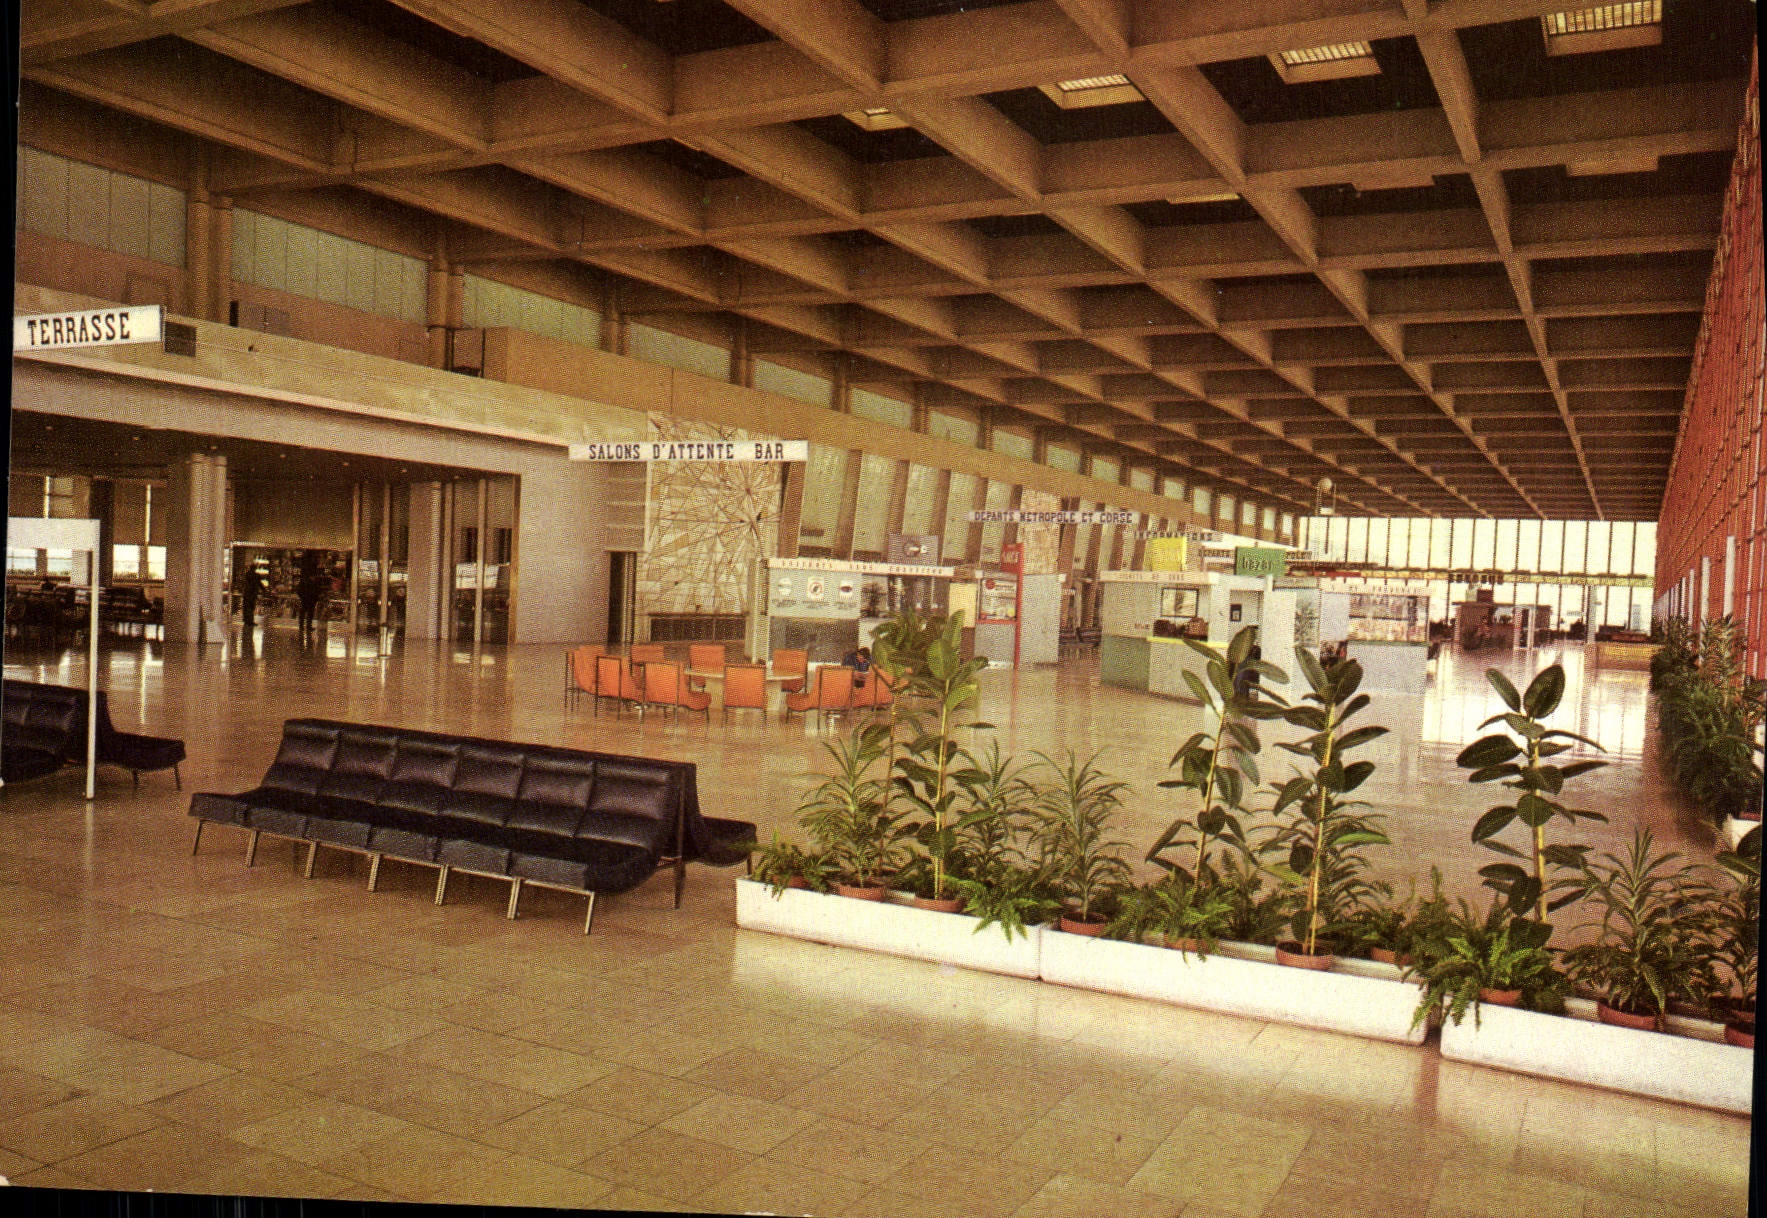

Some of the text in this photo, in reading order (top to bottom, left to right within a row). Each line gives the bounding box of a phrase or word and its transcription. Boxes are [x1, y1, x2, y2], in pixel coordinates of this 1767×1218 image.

[27, 312, 131, 346] TERRASSE
[588, 442, 785, 461] SALONS D'ATTENTE BAR
[1081, 512, 1094, 523] ET
[1100, 512, 1133, 524] CORSE
